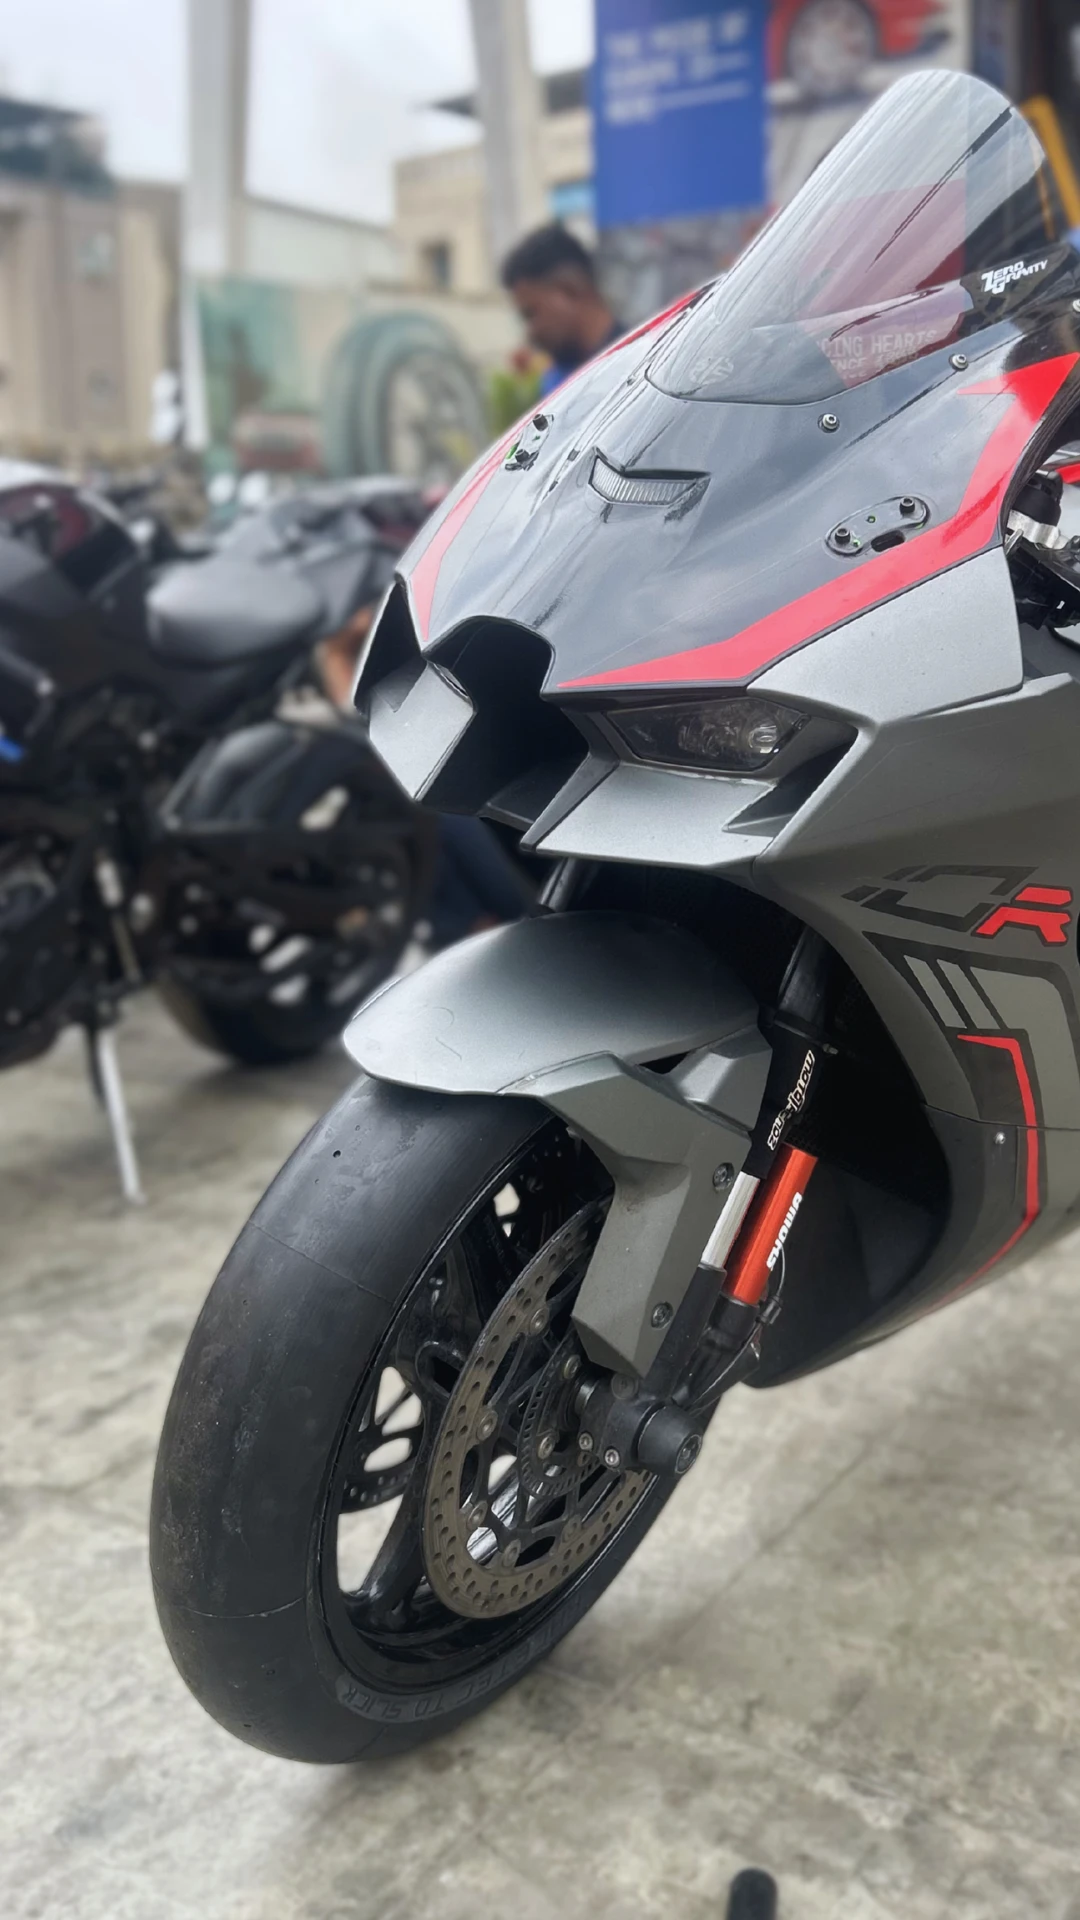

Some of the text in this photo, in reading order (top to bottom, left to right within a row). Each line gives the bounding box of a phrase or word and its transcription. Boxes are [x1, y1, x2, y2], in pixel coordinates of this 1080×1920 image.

[981, 260, 1024, 293] ZERO
[992, 259, 1048, 295] GRAVITY
[817, 330, 938, 358] CING HEARTS
[766, 1192, 803, 1271] SHOWA
[344, 1684, 405, 1719] SLICK
